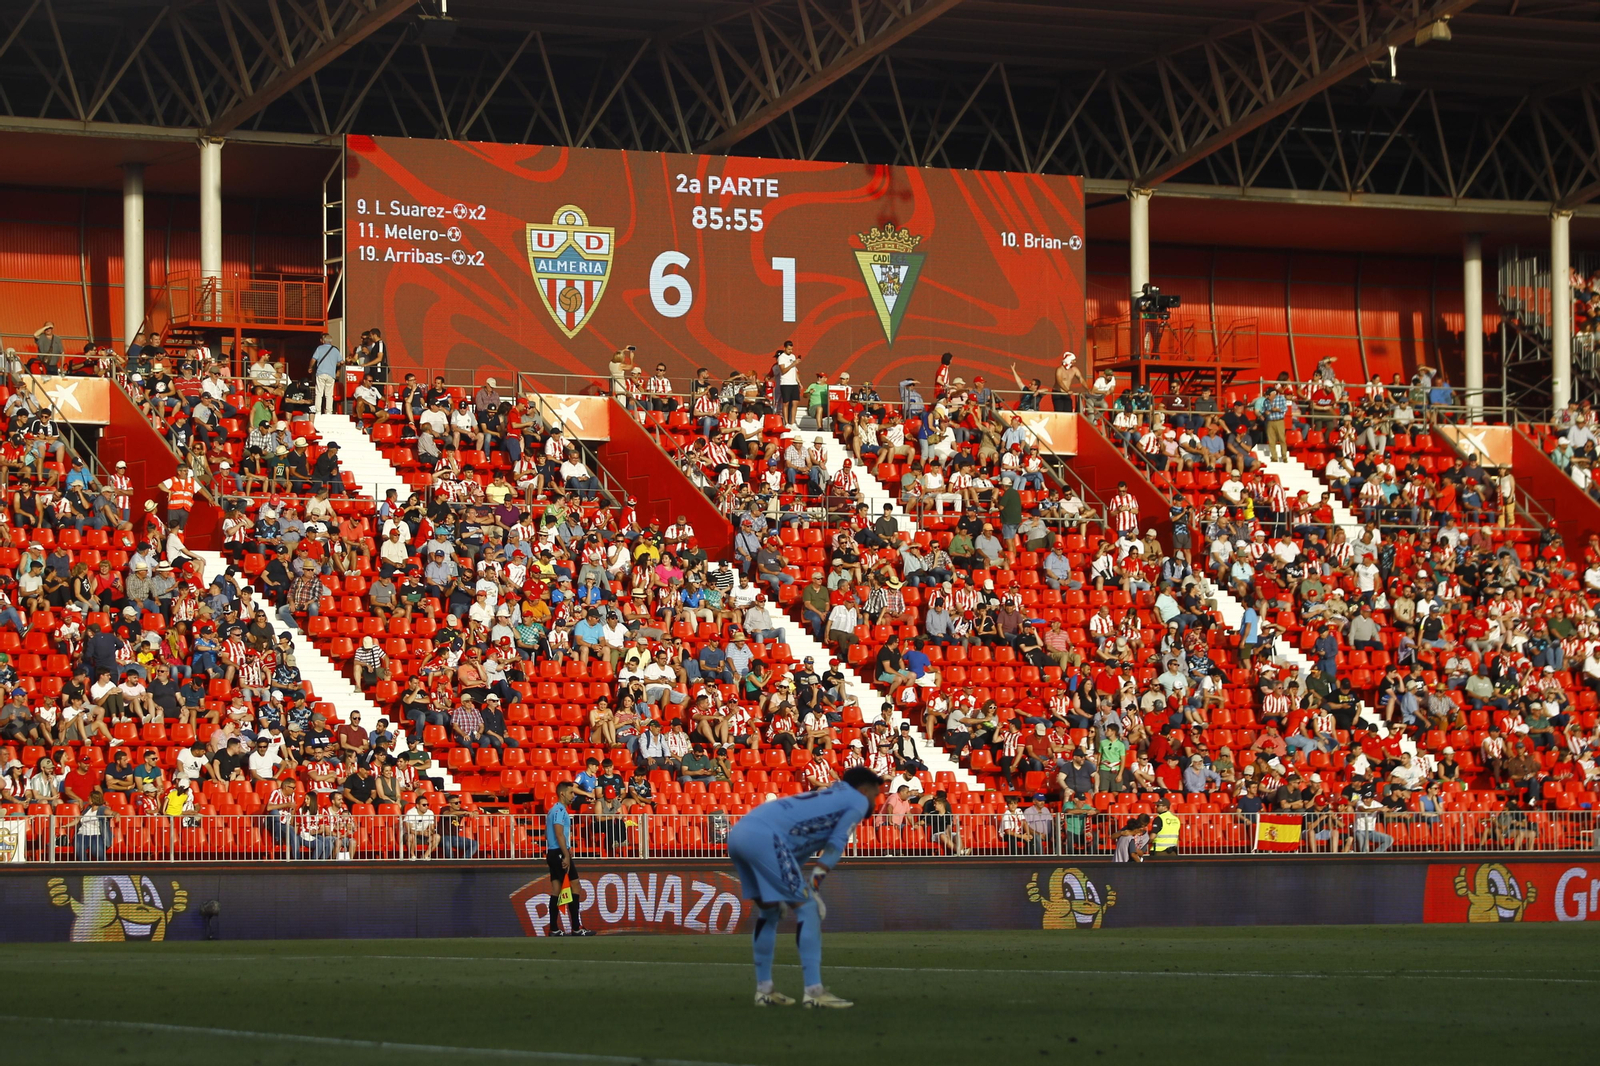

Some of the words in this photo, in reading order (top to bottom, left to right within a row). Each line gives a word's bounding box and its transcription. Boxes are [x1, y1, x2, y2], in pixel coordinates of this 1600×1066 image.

[676, 173, 701, 194] 2a
[708, 175, 779, 198] PARTE
[357, 198, 371, 215] 9.
[692, 205, 764, 232] 85:55
[358, 222, 380, 239] 11.
[537, 232, 555, 248] U
[585, 235, 604, 250] D
[1000, 232, 1020, 248] 10.
[358, 245, 380, 262] 19.
[538, 259, 603, 274] ALMERIA
[649, 250, 693, 318] 6
[771, 256, 796, 323] 1
